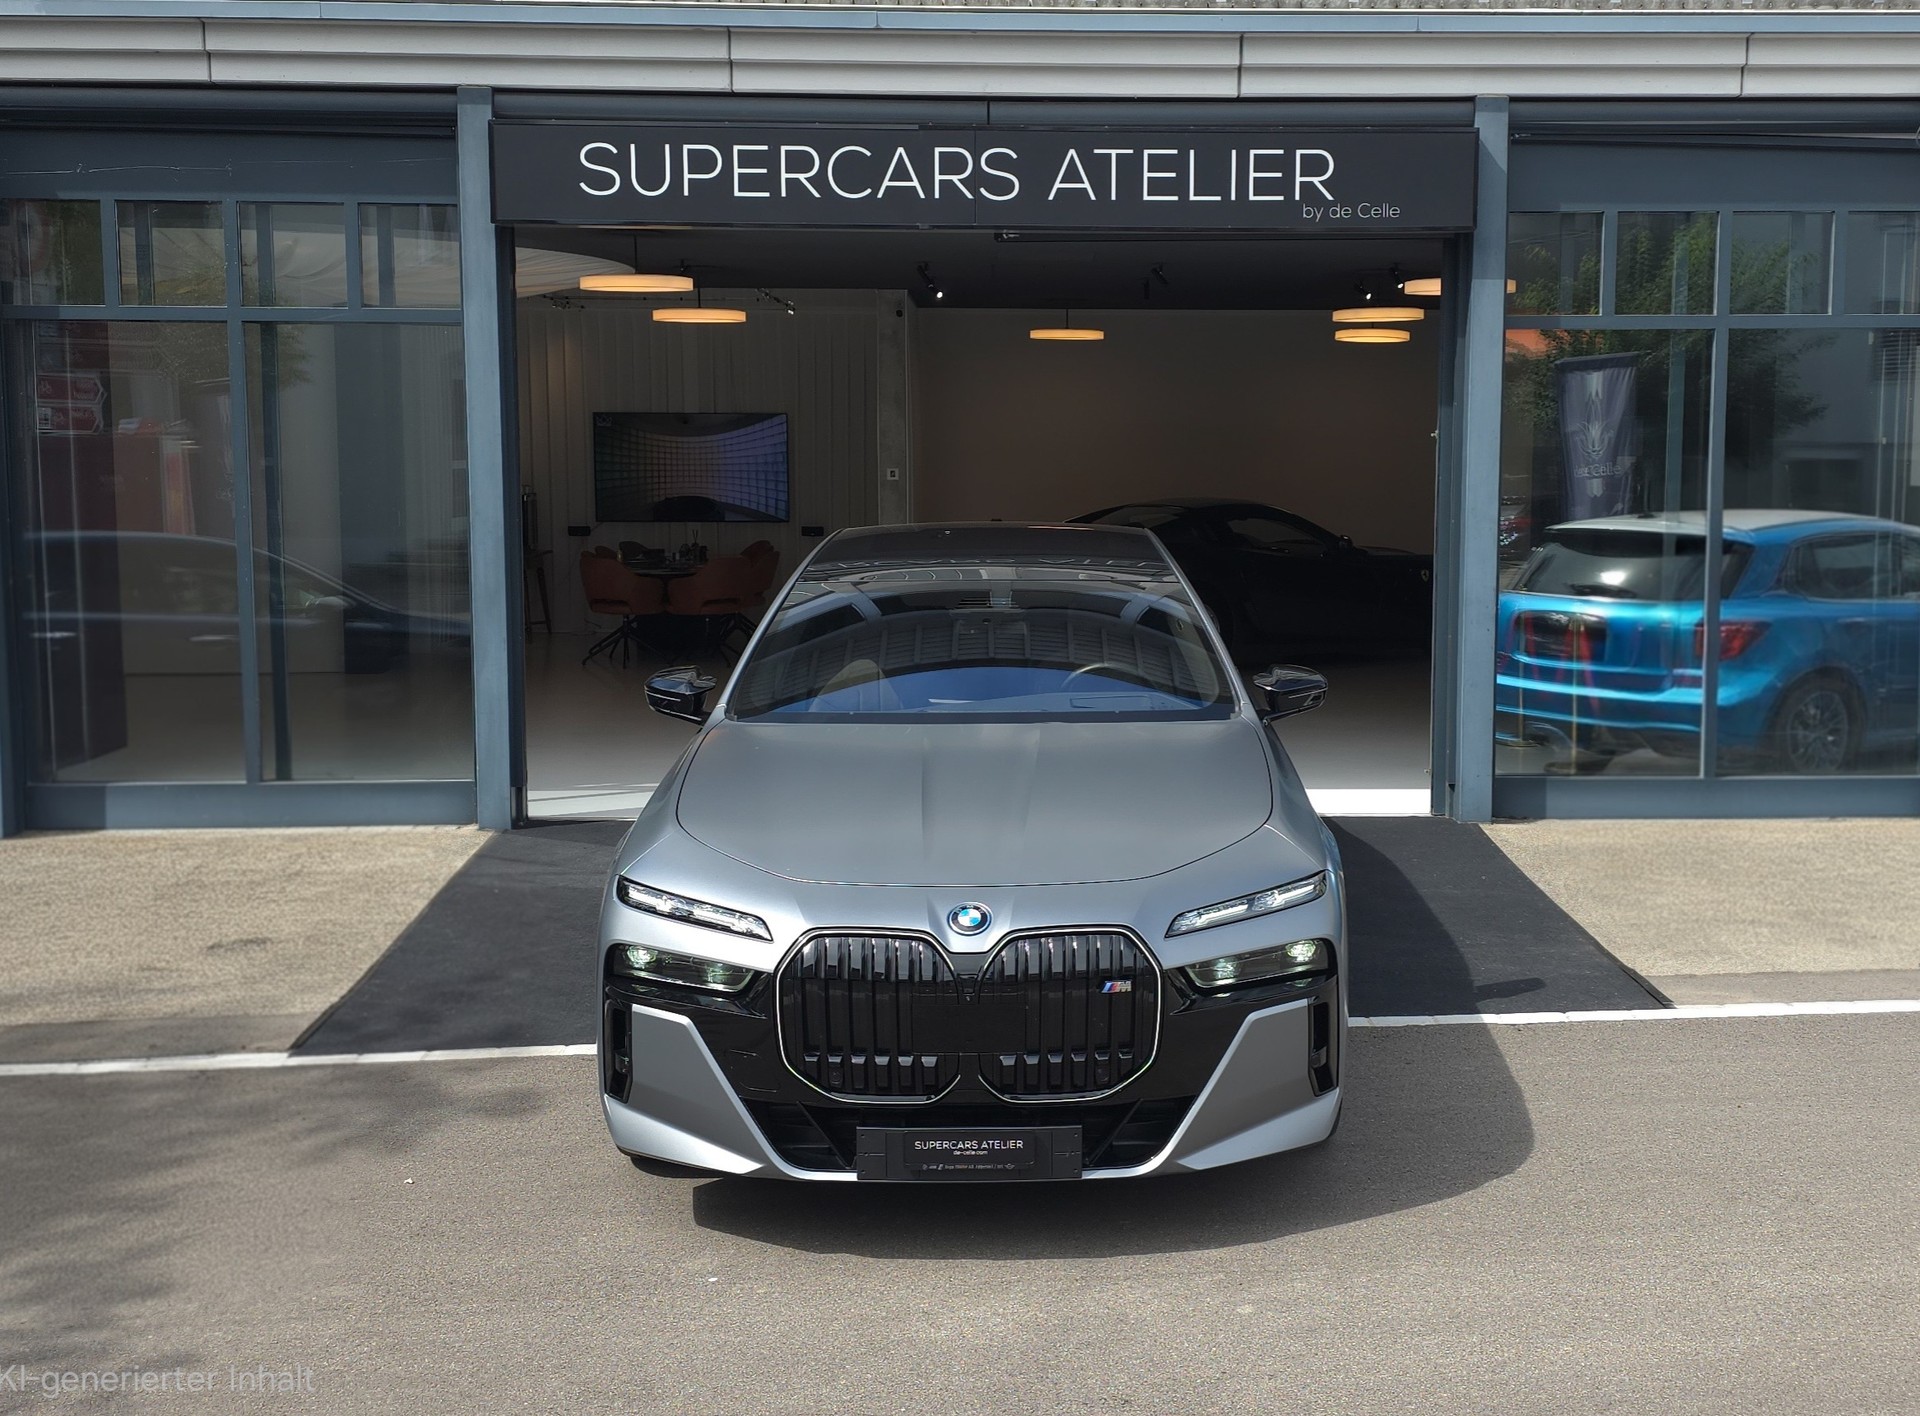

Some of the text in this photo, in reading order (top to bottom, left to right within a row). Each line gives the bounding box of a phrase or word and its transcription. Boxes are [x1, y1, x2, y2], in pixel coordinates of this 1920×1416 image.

[580, 142, 1335, 201] SUPERCARS ATELIER
[1302, 202, 1400, 222] by de Celle
[914, 1139, 1023, 1149] SUPERCARS ATELIER
